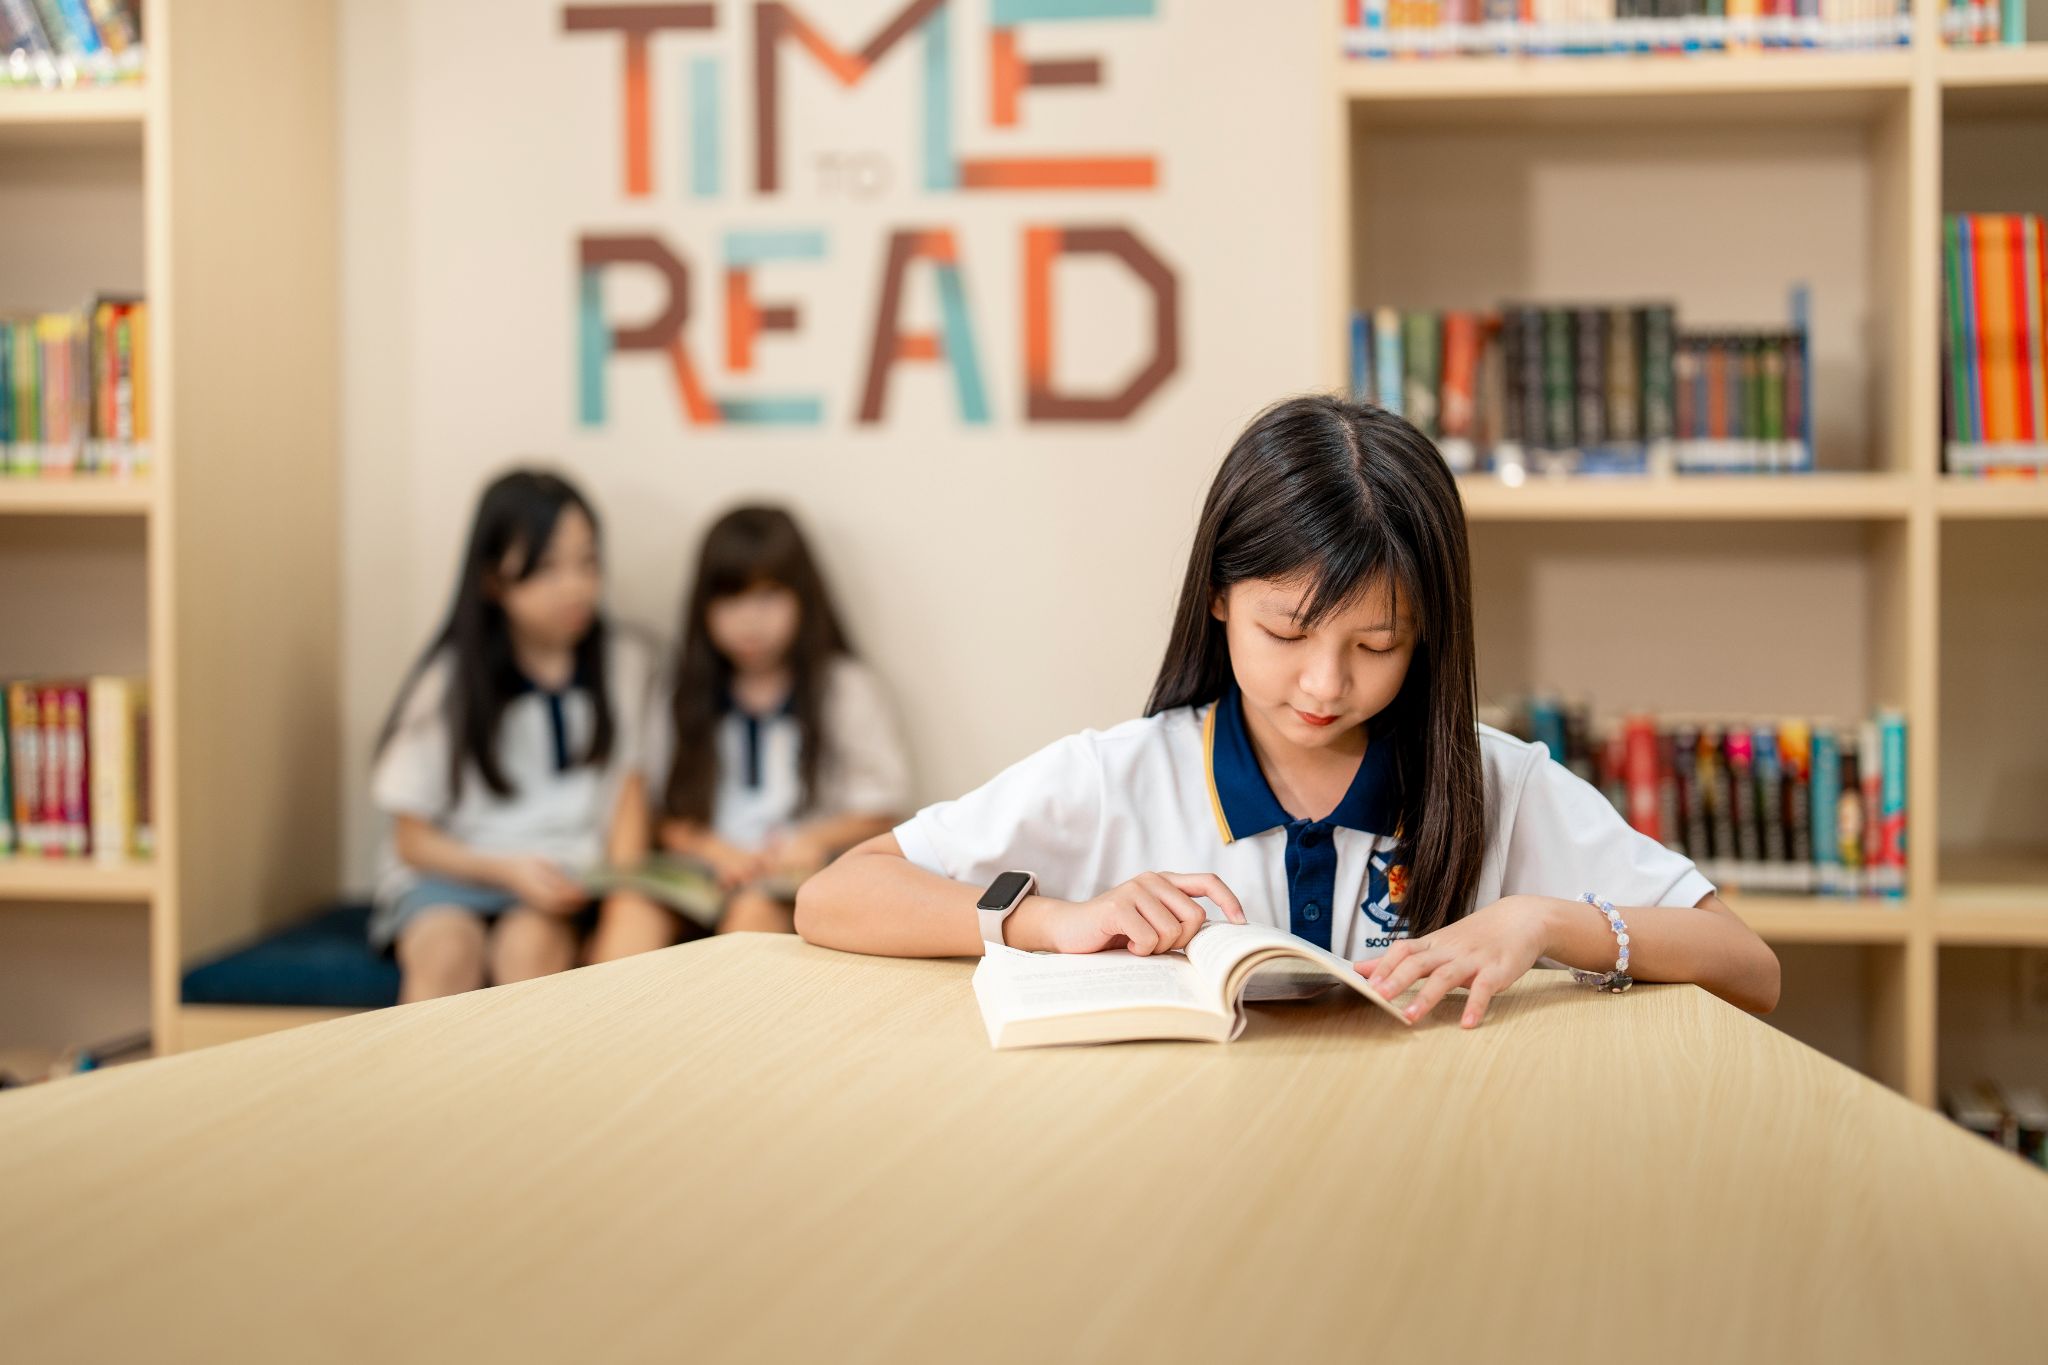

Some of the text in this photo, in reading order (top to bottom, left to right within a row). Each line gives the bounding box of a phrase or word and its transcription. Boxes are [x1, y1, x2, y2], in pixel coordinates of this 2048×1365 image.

[562, 0, 1160, 198] TIME
[813, 152, 896, 203] TO
[577, 224, 1184, 426] READ
